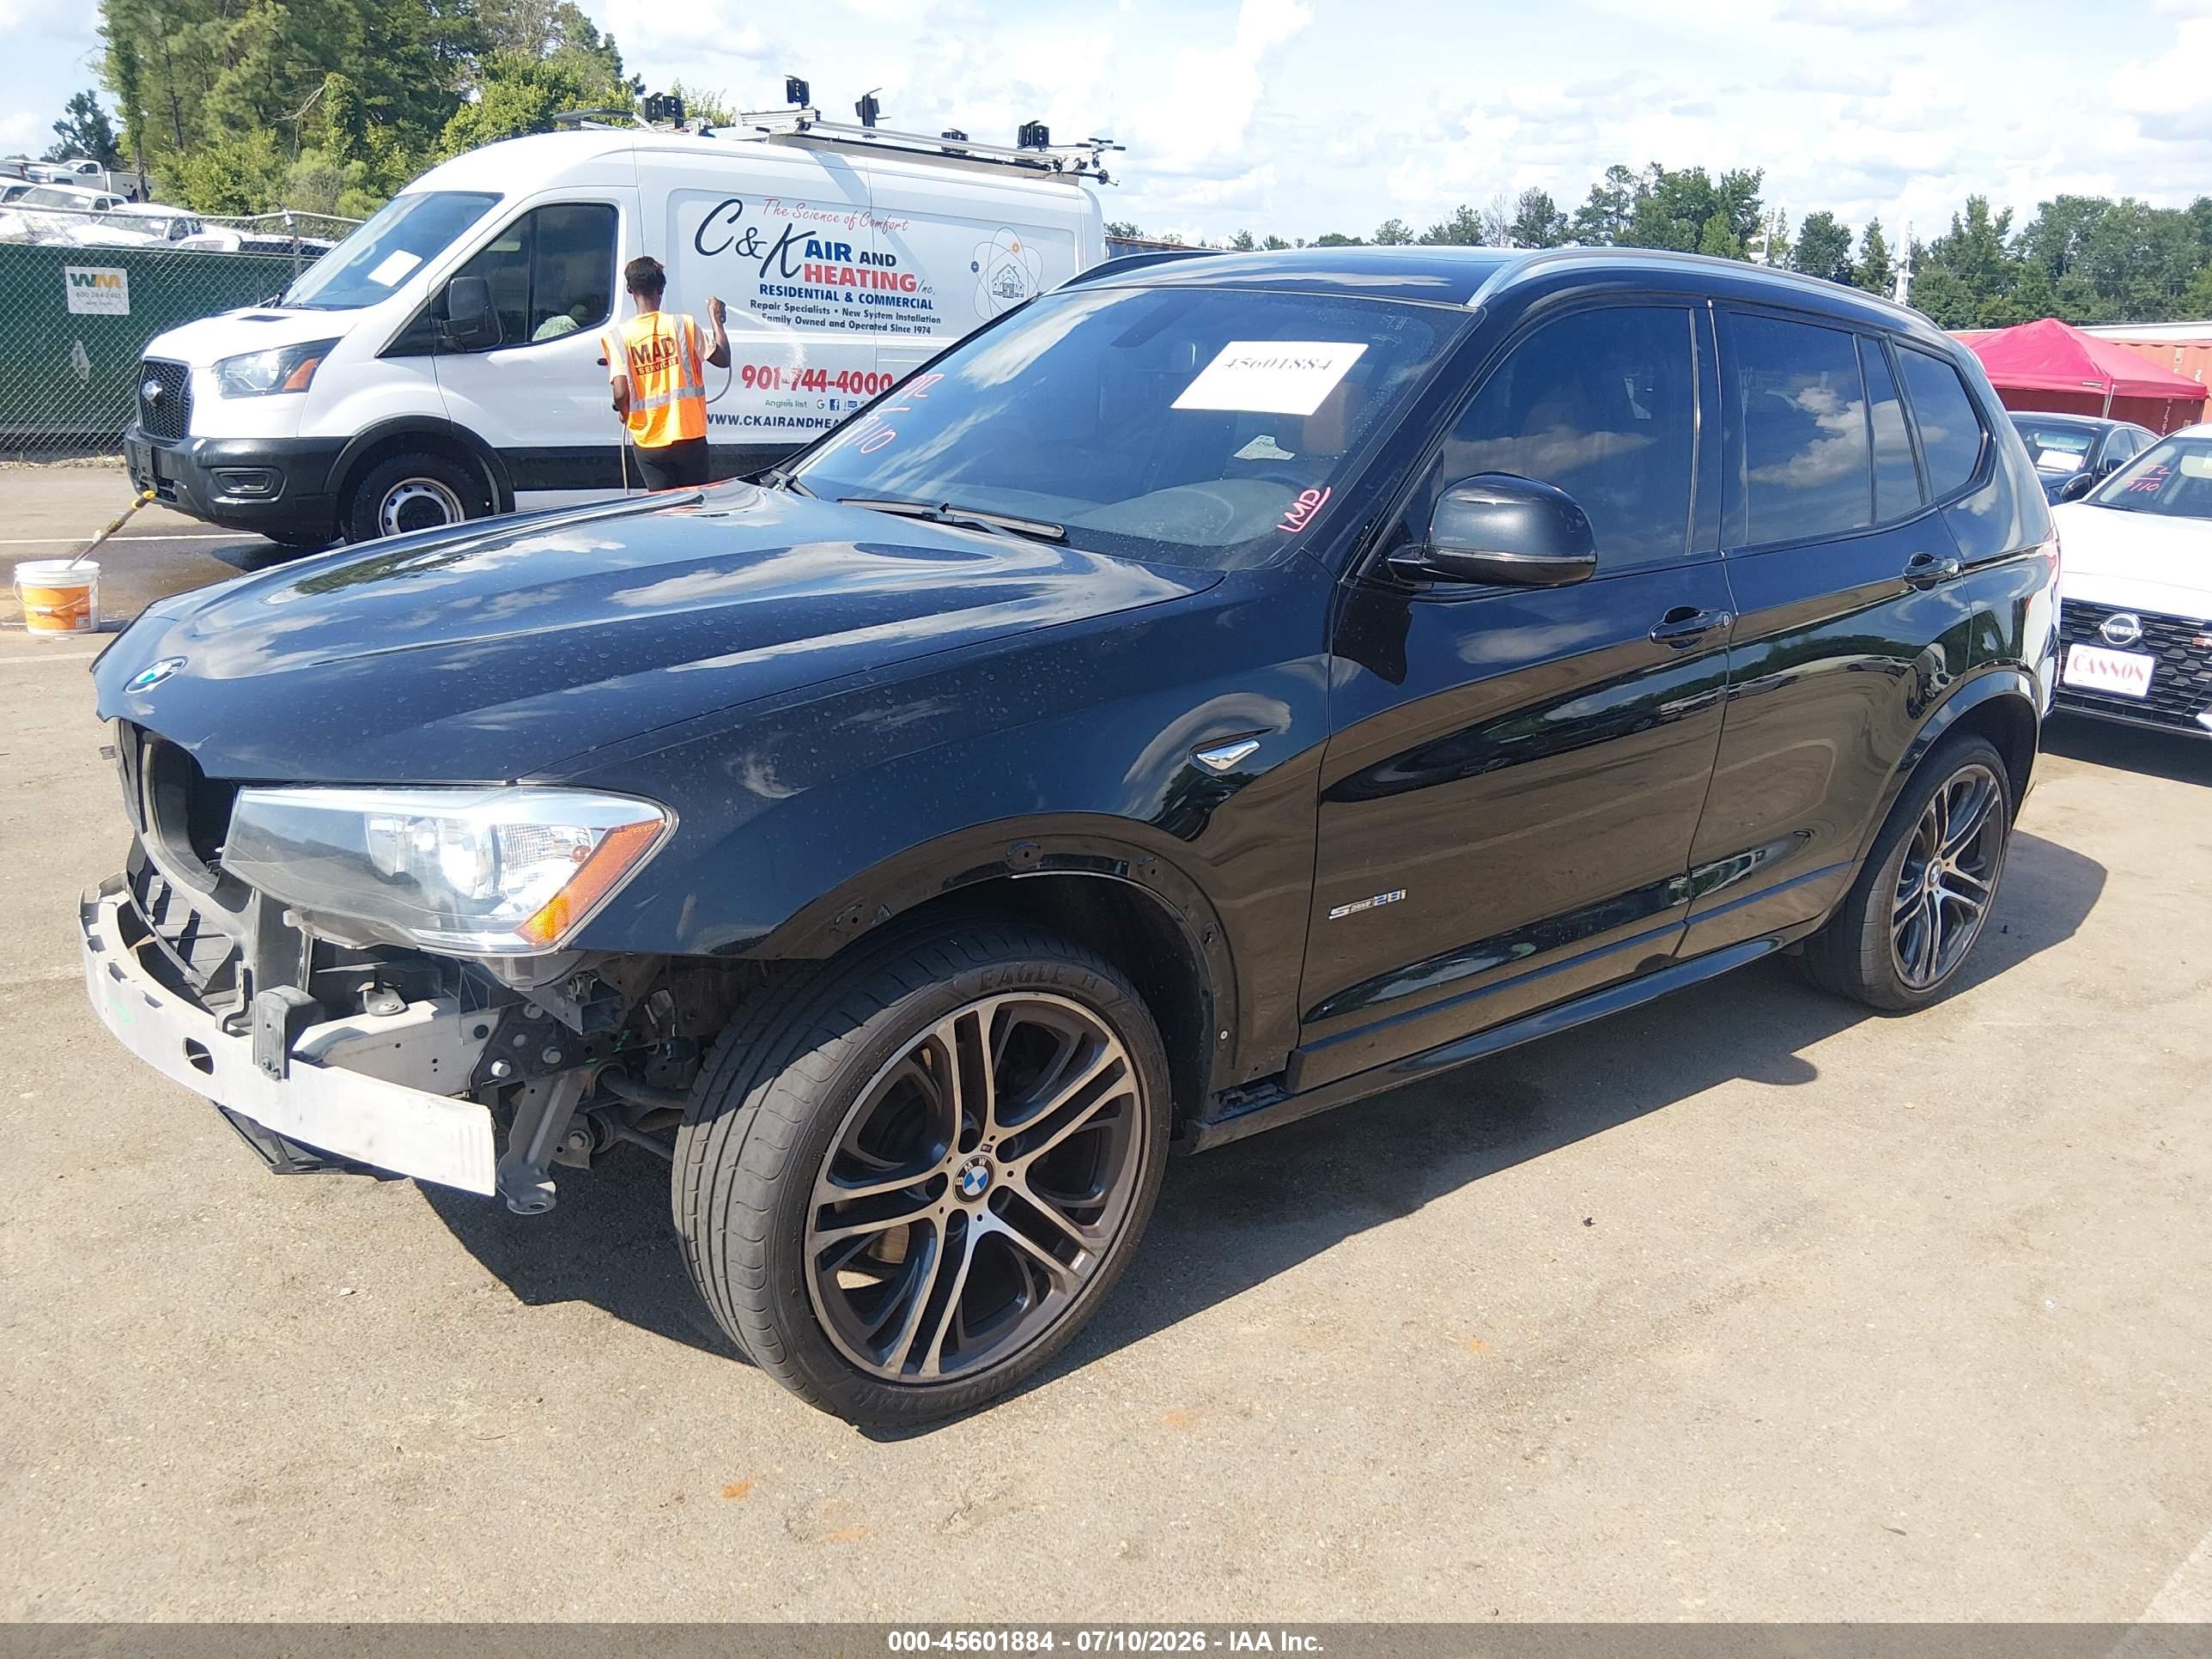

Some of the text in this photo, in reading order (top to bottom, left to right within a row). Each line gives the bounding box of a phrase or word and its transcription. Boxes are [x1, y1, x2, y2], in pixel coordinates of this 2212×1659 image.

[763, 198, 909, 235] The Science of Comfort
[804, 239, 853, 263] AIR
[859, 251, 897, 267] AND
[69, 273, 124, 289] WM
[804, 263, 917, 293] HEATING
[759, 283, 934, 310] RESIDENTIAL & COMMERCIAL
[750, 299, 941, 325] Repair Specialists New System Installation
[794, 315, 826, 327] Owned
[829, 320, 846, 329] and
[848, 319, 888, 331] Operated
[890, 324, 911, 334] Since
[913, 325, 932, 336] 1974
[630, 337, 677, 367] MAD
[741, 364, 893, 397] 901-744-4000
[794, 400, 808, 410] list
[707, 413, 844, 428] WWW.CKAIRANDHEA
[2100, 623, 2142, 638] NISSAN
[955, 1157, 988, 1186] BMW
